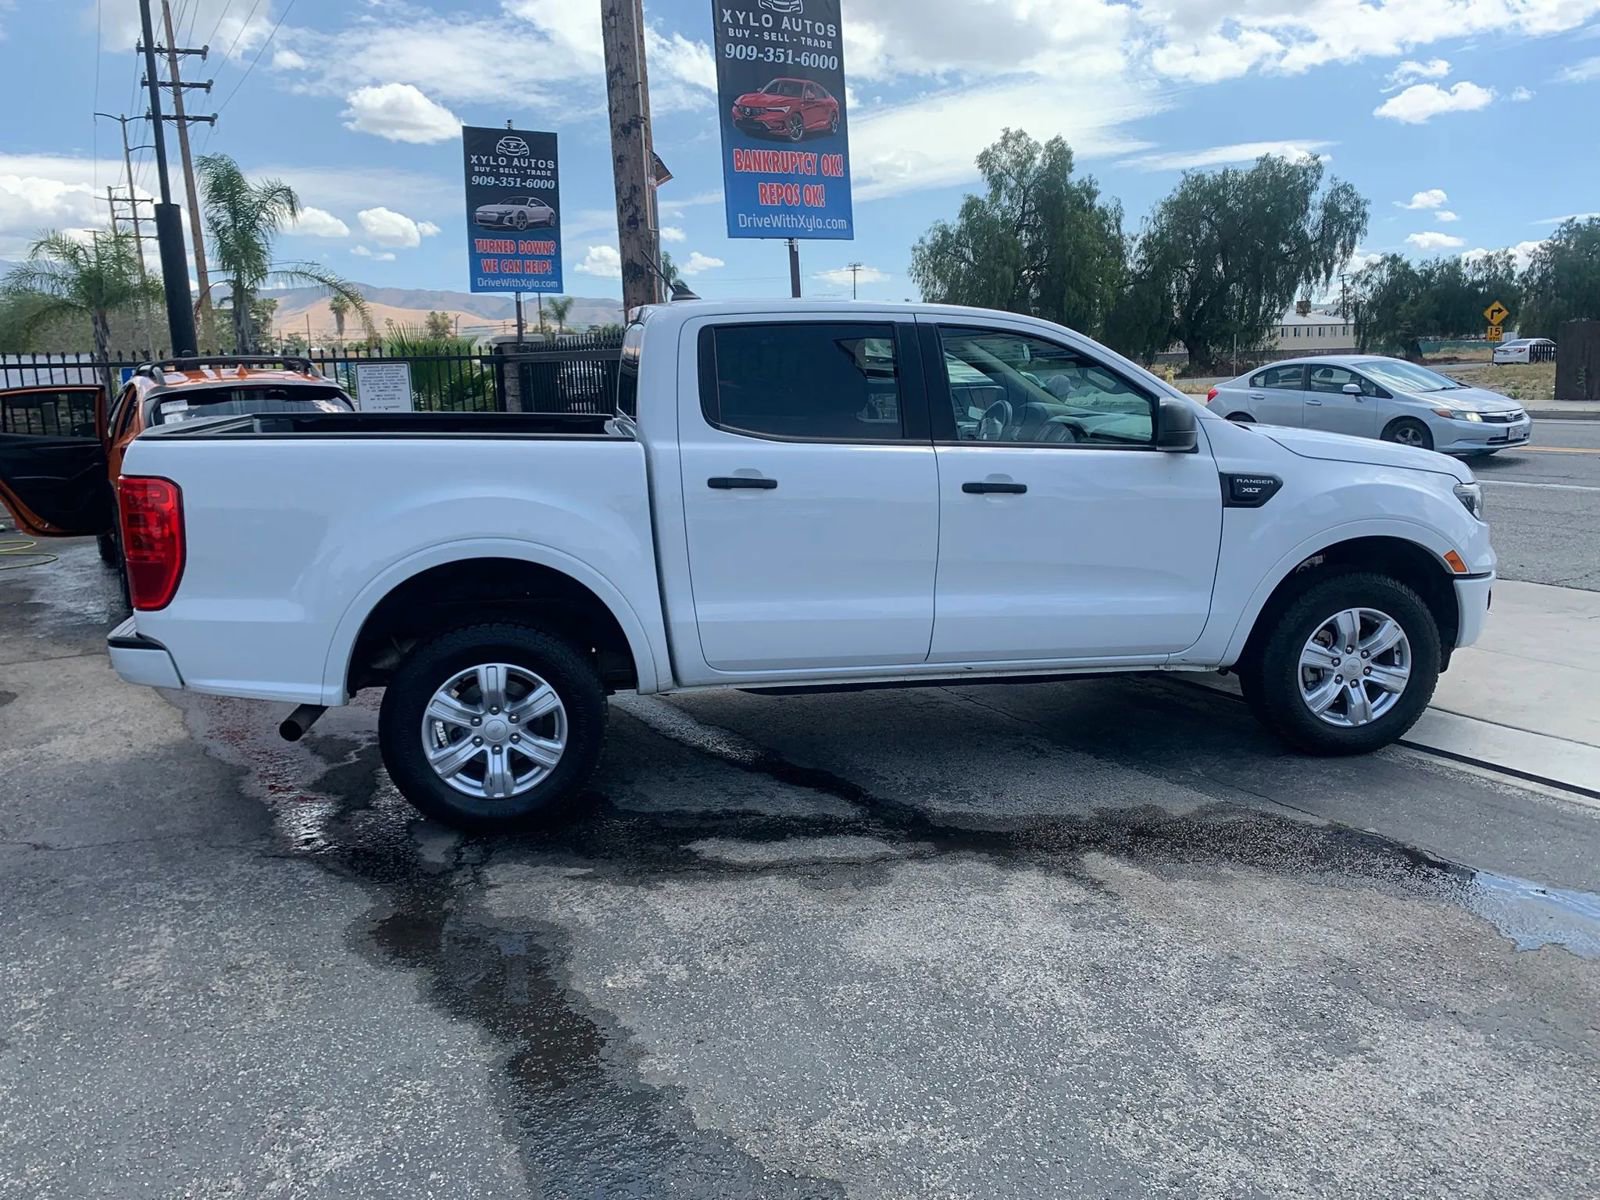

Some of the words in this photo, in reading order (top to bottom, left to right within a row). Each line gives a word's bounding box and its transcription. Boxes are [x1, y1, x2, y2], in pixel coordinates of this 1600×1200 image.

[722, 8, 773, 28] XYLO
[781, 16, 837, 37] AUTOS
[728, 27, 750, 38] BUY
[763, 31, 790, 42] SELL
[800, 36, 833, 49] TRADE
[725, 43, 839, 71] 909-351-6000
[470, 154, 507, 166] XYLO
[512, 157, 555, 169] AUTOS
[733, 148, 818, 176] BANKRUPTCY
[821, 153, 844, 177] OK!
[471, 175, 556, 190] 909-351-6000
[758, 182, 801, 207] REPOS
[803, 184, 826, 208] OK!
[737, 213, 847, 231] DriveWithXylo.com
[474, 238, 517, 254] TURNED
[518, 240, 557, 256] DOWN?
[481, 258, 499, 274] WE
[501, 259, 522, 274] CAN
[524, 259, 553, 275] HELP!
[477, 277, 558, 290] DriveWithXylo.com
[1489, 327, 1501, 336] 15
